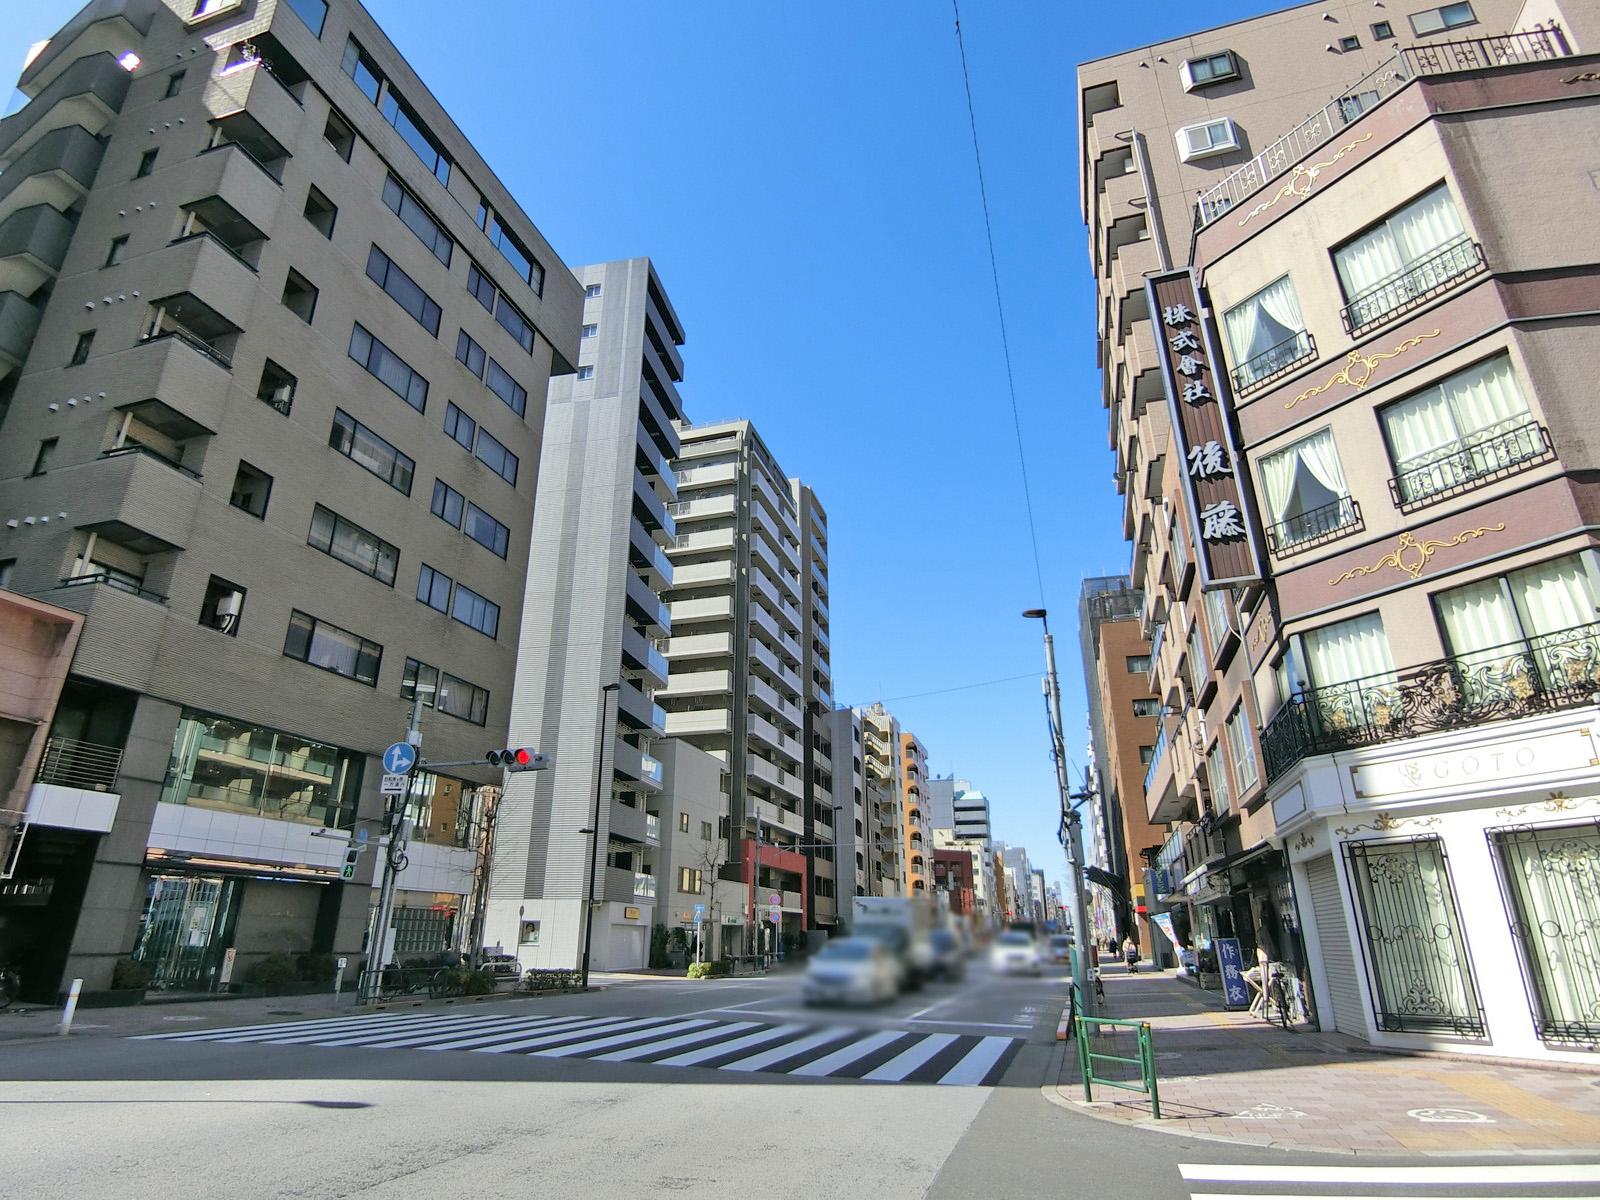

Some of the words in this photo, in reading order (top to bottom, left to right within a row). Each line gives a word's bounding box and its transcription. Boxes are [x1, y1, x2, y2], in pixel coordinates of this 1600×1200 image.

[1163, 303, 1211, 403] 株式會社
[1187, 440, 1245, 540] 後藤
[1434, 747, 1535, 779] GOTO
[1221, 943, 1244, 1001] 作務衣
